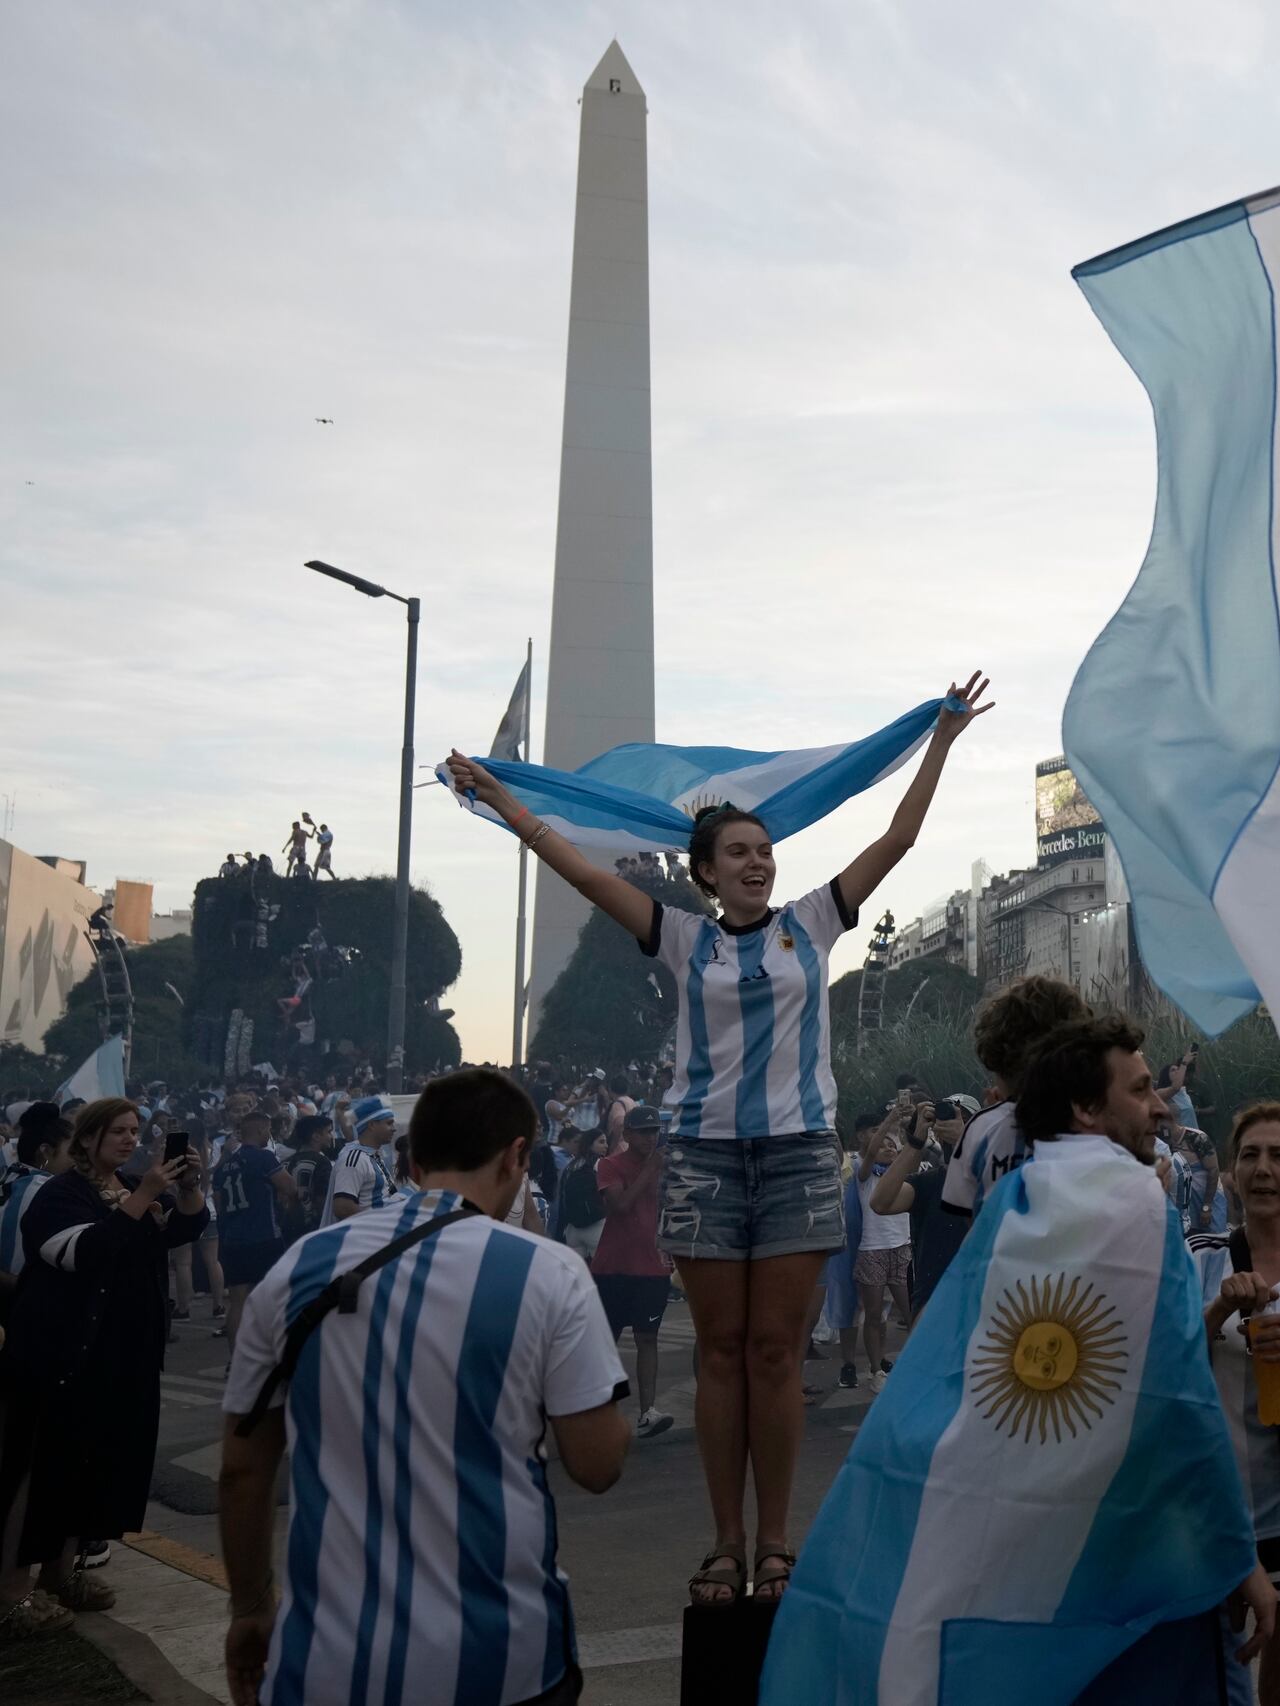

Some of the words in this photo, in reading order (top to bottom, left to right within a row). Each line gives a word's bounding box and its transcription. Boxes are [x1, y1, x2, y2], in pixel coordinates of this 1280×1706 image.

[1037, 830, 1105, 857] Mercedes-Benz
[992, 1154, 1034, 1181] ME
[222, 1173, 250, 1213] 11
